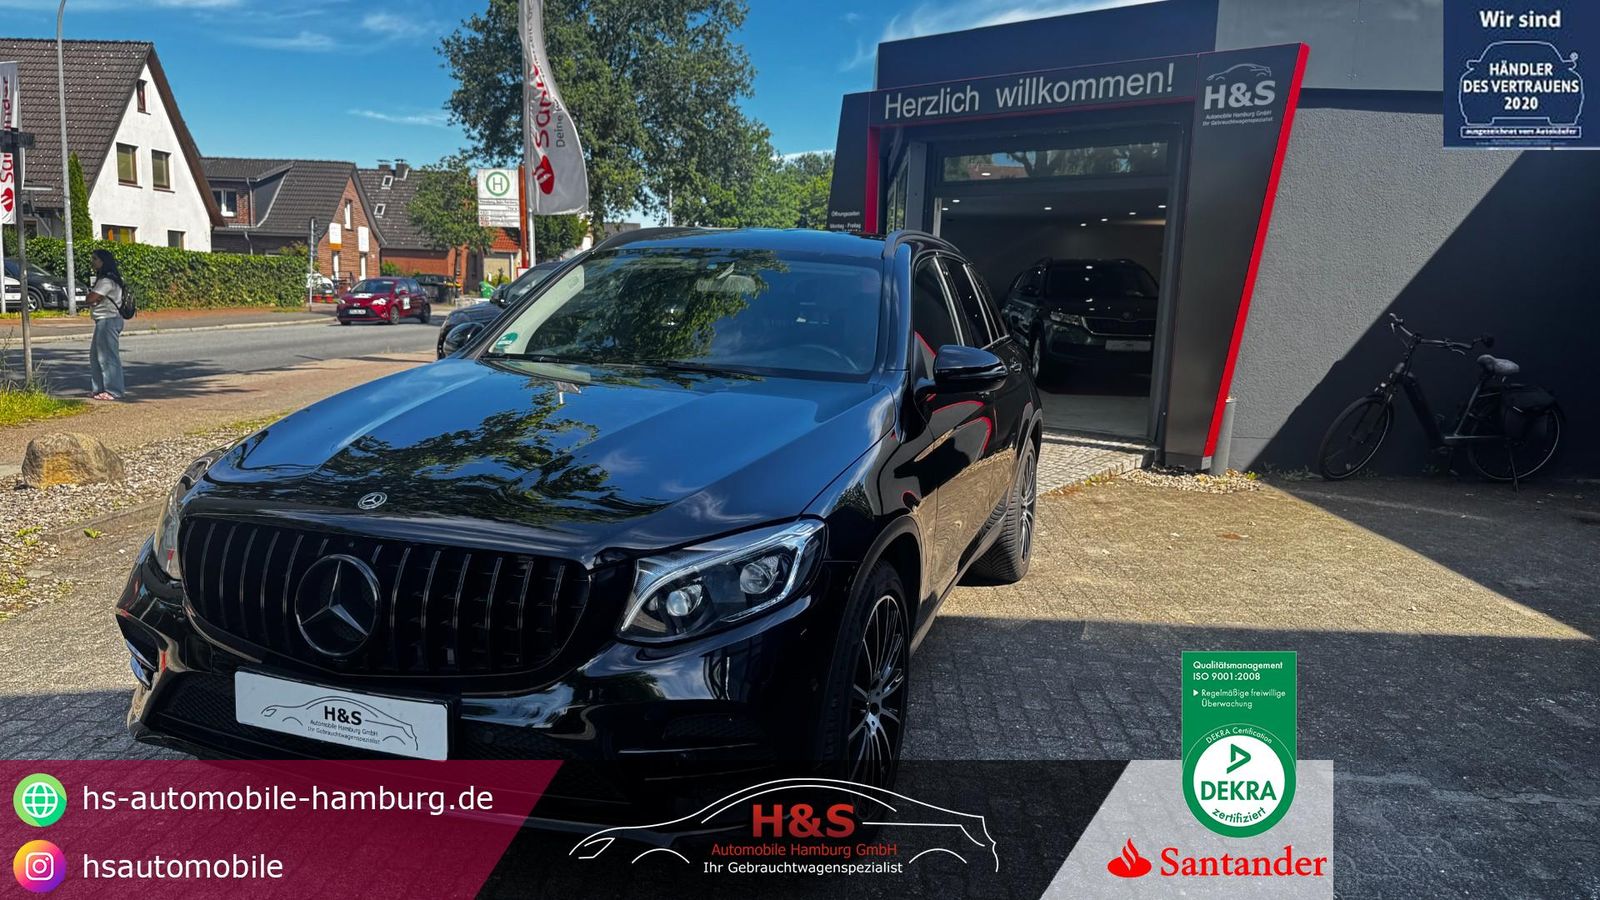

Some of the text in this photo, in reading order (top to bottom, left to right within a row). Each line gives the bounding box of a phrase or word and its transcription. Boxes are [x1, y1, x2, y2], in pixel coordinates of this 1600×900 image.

[884, 63, 1175, 120] Herzlich willkommen!
[1203, 80, 1276, 110] H&S
[492, 177, 503, 191] H
[324, 705, 362, 726] H&S
[310, 719, 379, 736] Automobile Hamburg GmbH
